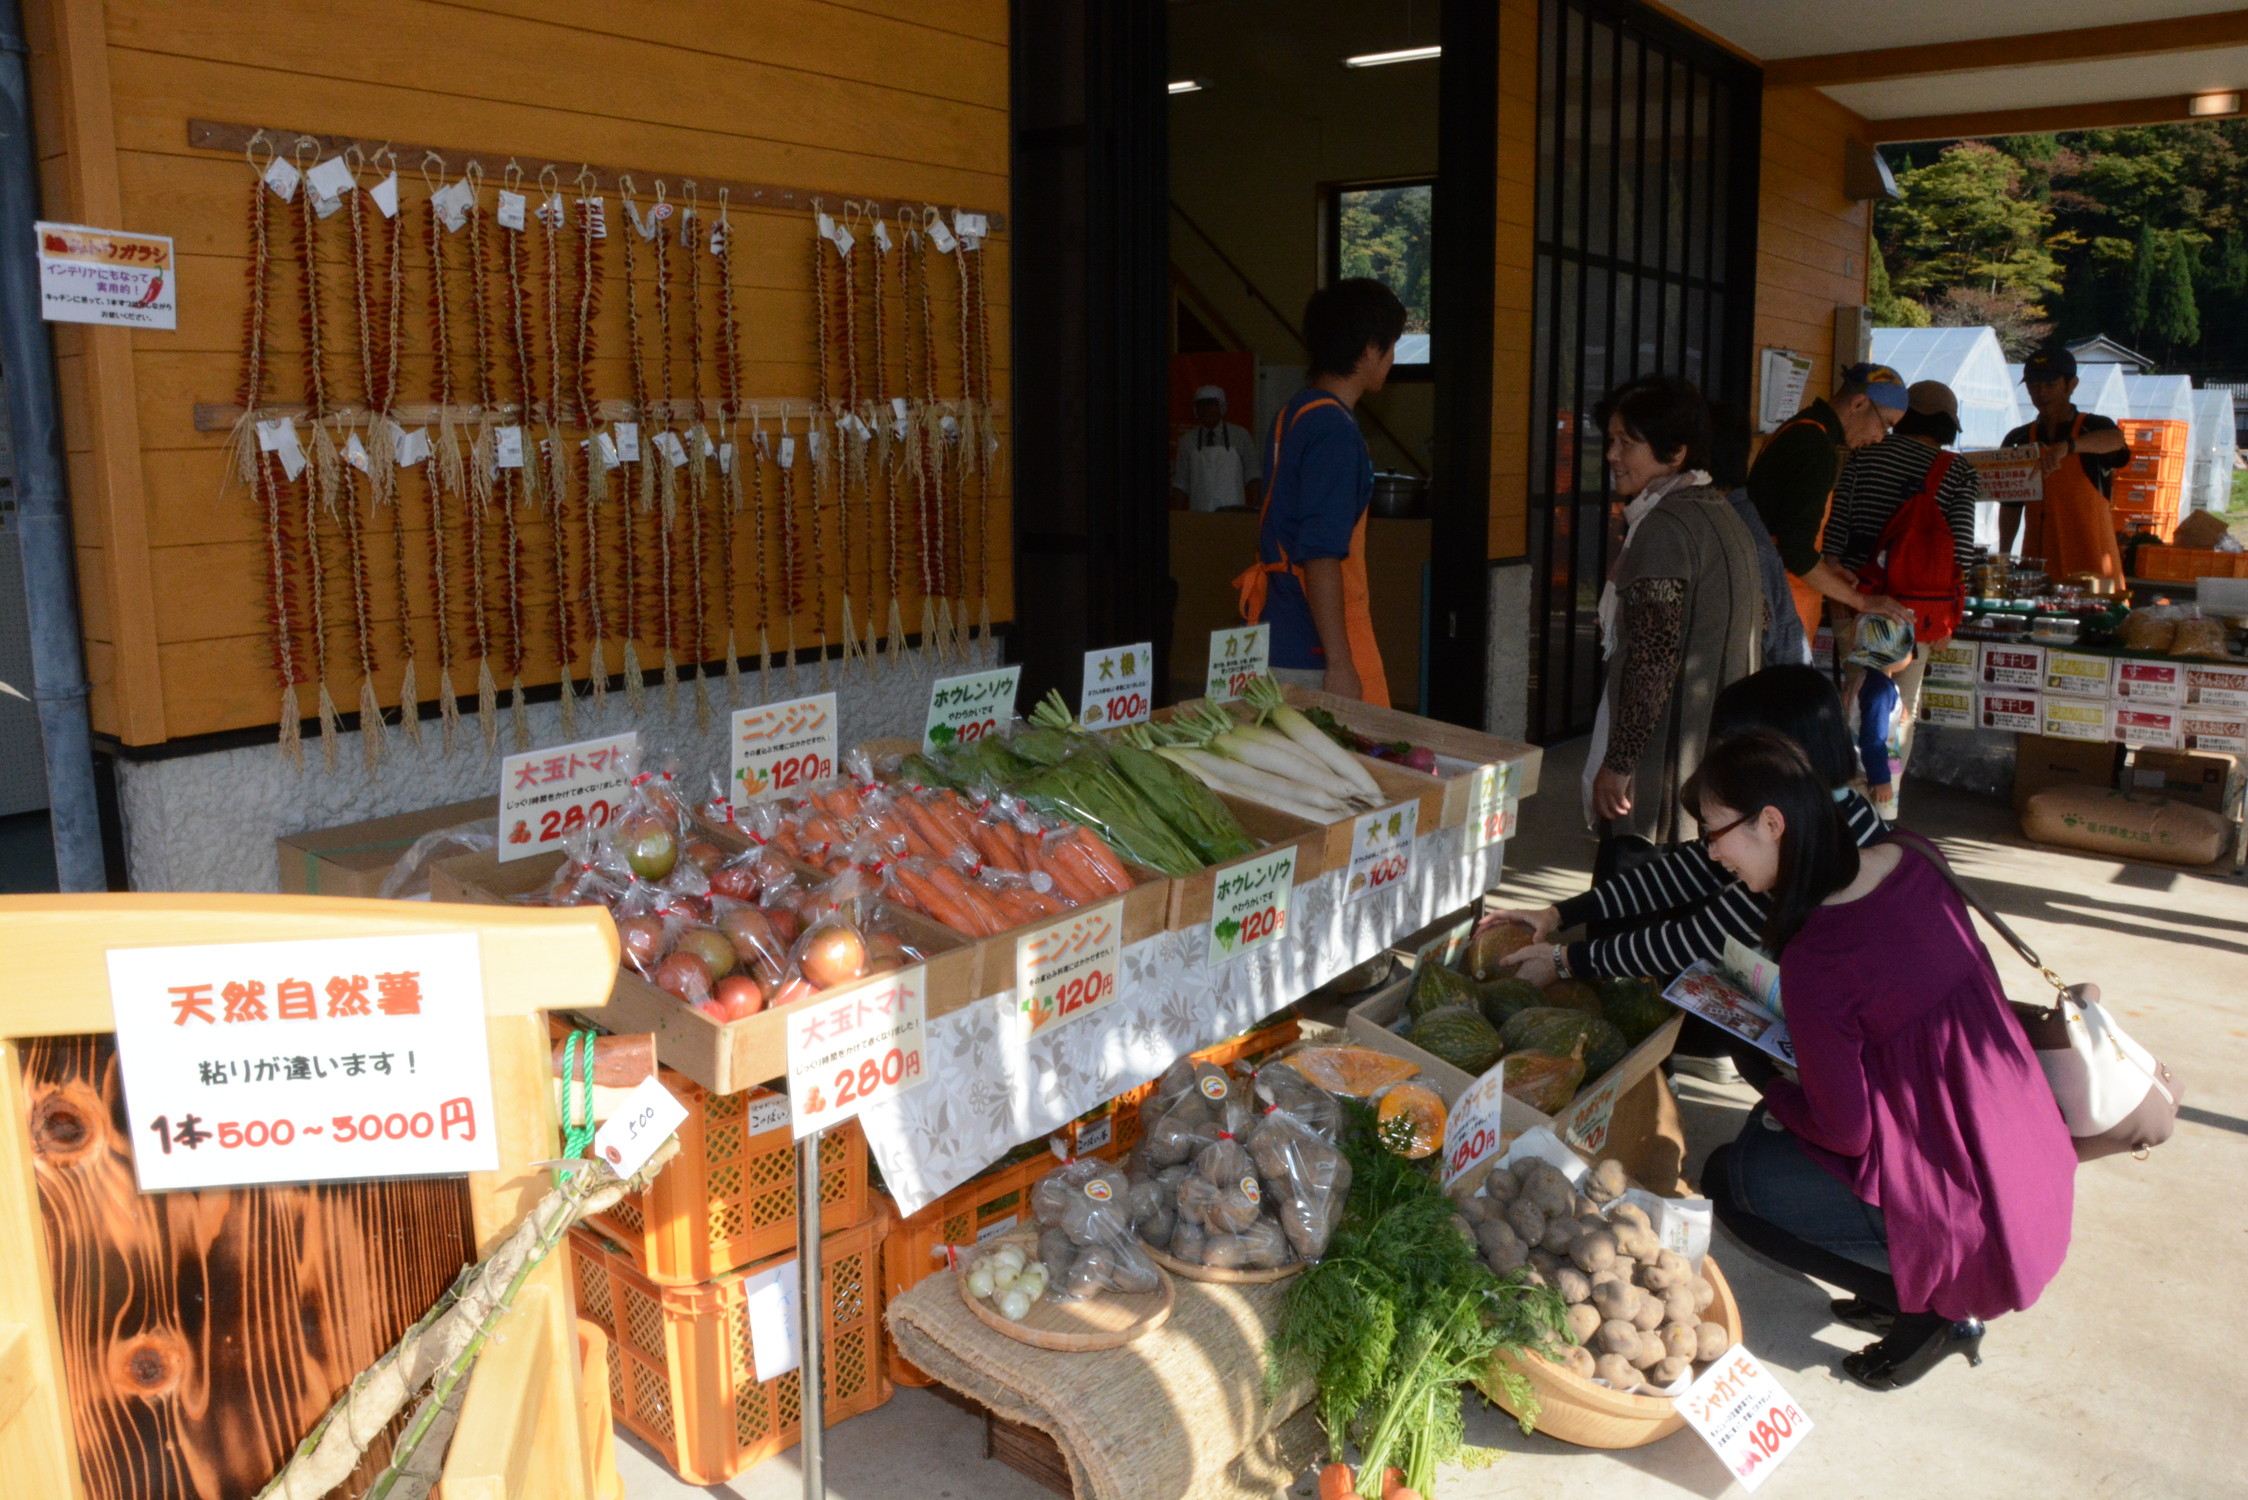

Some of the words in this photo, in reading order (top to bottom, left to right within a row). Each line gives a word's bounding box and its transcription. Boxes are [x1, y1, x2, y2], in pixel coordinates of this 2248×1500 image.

[47, 264, 149, 283] インテリアにもなって
[1098, 652, 1135, 681] 大根
[1992, 652, 2031, 667] 梅干し
[743, 704, 827, 741] ニンジン
[1106, 693, 1147, 722] 100円
[1991, 698, 2028, 713] 梅干し
[514, 745, 622, 789] 大玉トマト
[771, 753, 830, 790] 120円
[1027, 916, 1111, 968] ニンジン
[1240, 906, 1285, 945] 120円
[168, 971, 423, 1026] 天然自然薯
[1056, 970, 1113, 1017] 120円
[801, 983, 915, 1049] 大玉トマト
[796, 1018, 919, 1076] じっくり時間をかけて赤くなりました！
[198, 1050, 416, 1085] 粘りが違います！
[834, 1047, 920, 1108] 280円
[629, 1107, 654, 1140] 500
[1689, 1357, 1758, 1422] ジャガイモ
[1749, 1404, 1803, 1459] 180円
